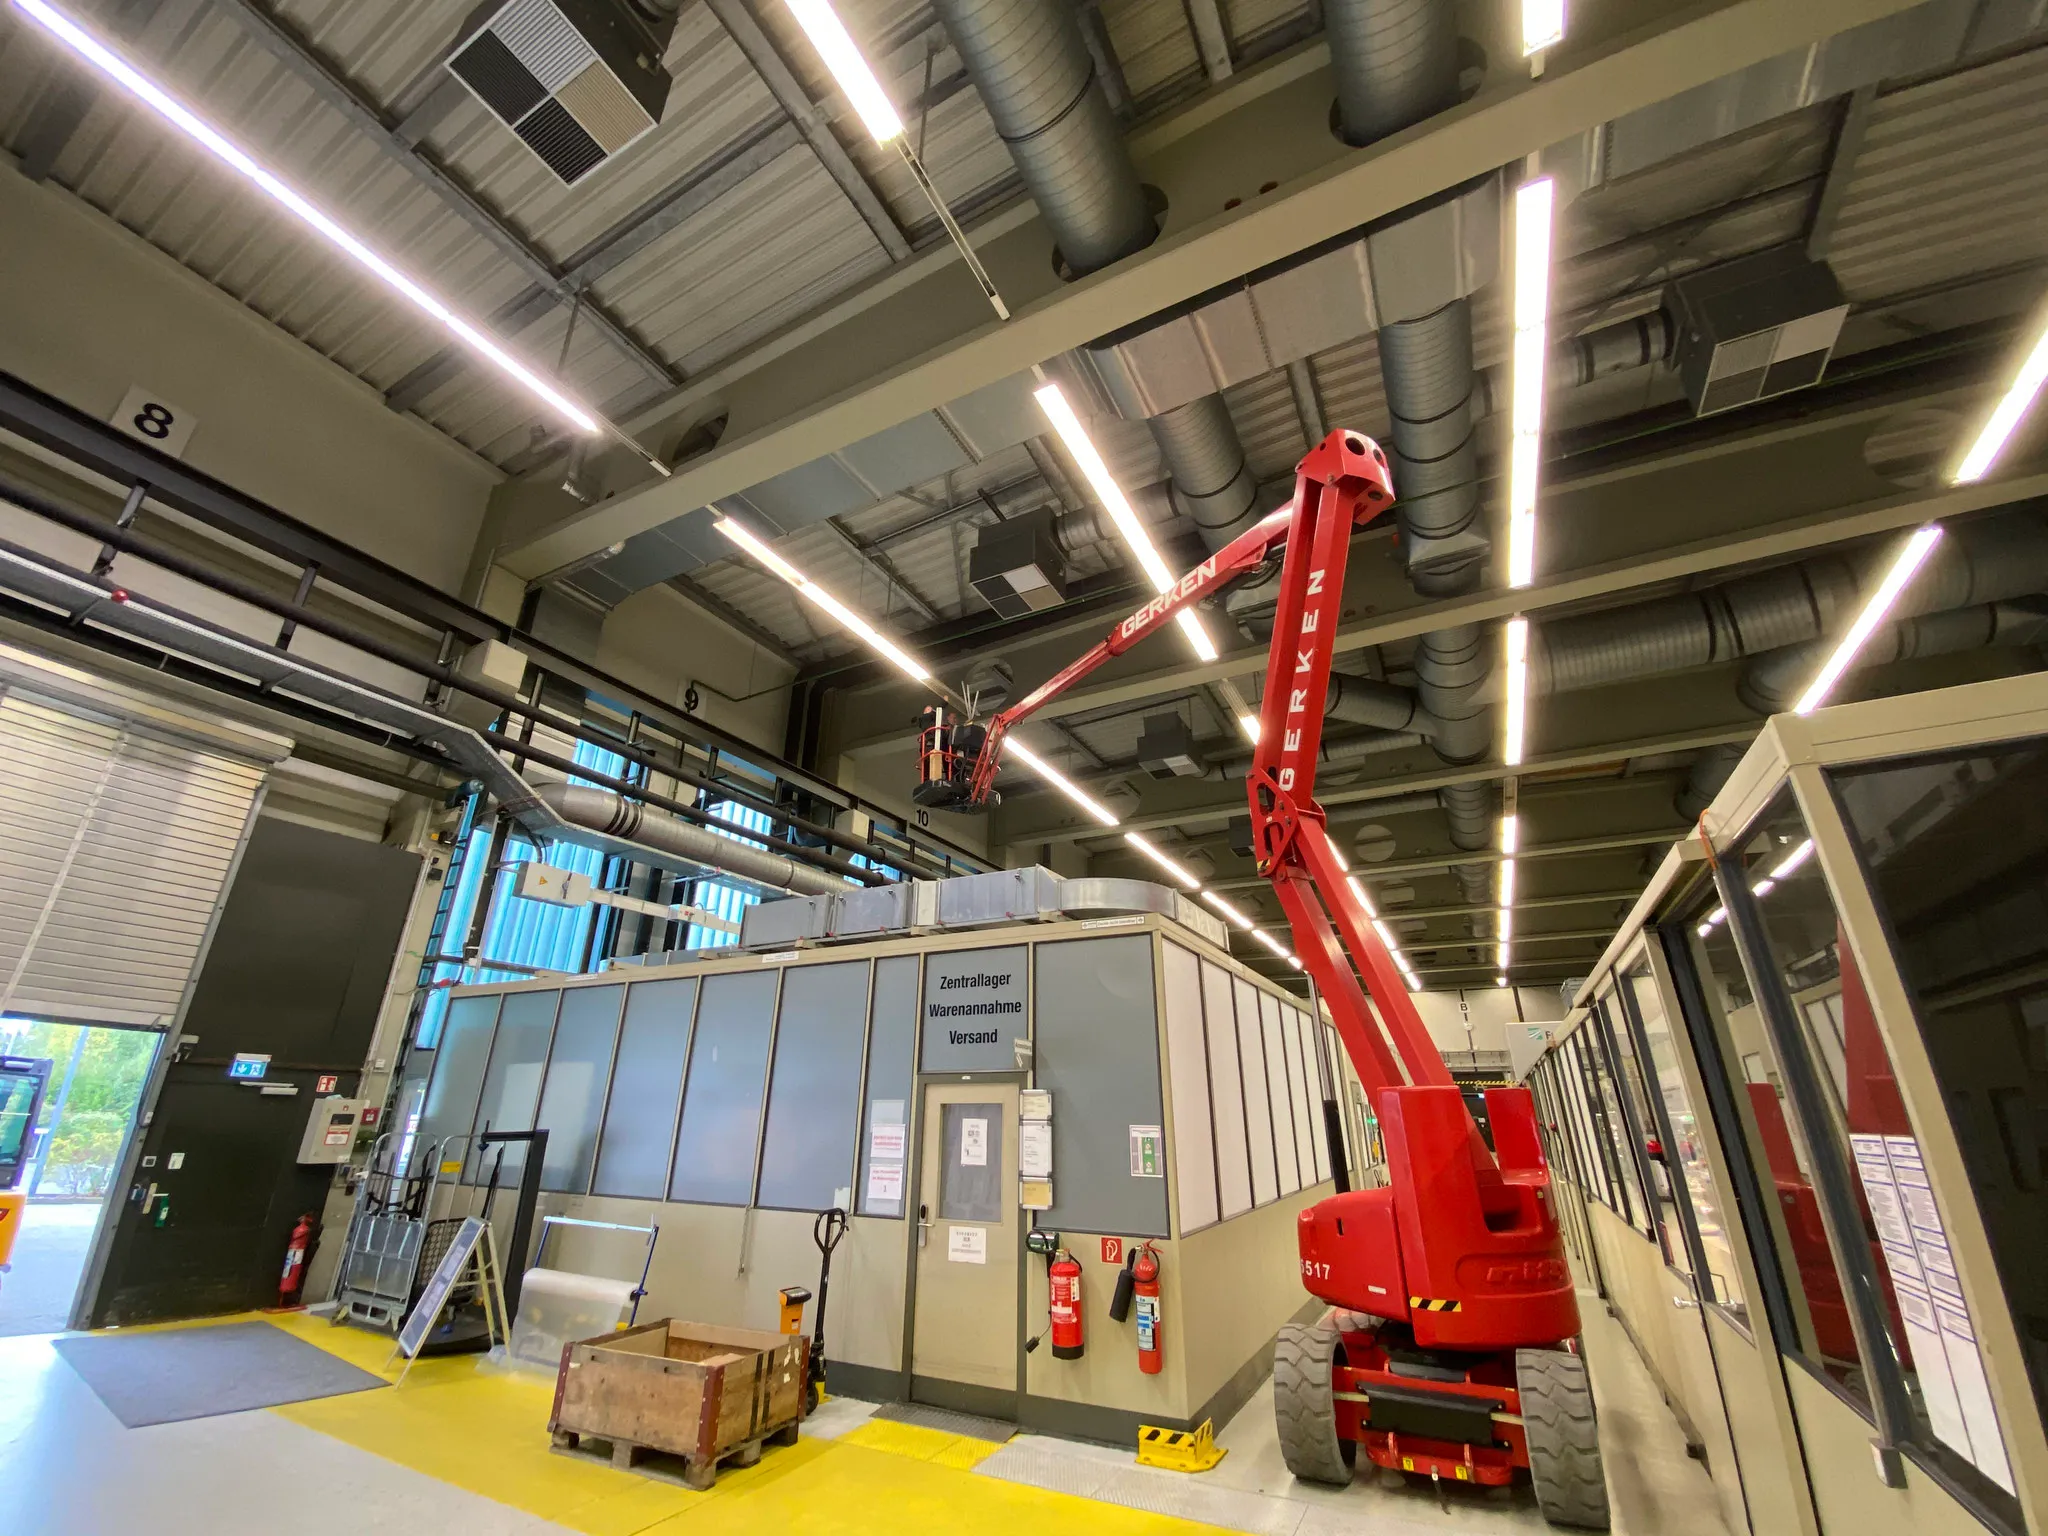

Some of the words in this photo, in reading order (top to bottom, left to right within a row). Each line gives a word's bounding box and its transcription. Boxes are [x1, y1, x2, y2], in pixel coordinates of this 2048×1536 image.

[134, 403, 174, 439] 8
[1121, 556, 1216, 638] GERKEN
[1278, 569, 1325, 792] GERKEN
[684, 688, 699, 711] 9
[916, 808, 929, 827] 10
[940, 973, 1012, 990] Zentrallager
[929, 1000, 1022, 1017] Warenannahme
[1460, 1003, 1468, 1012] B
[949, 1028, 998, 1045] Versand
